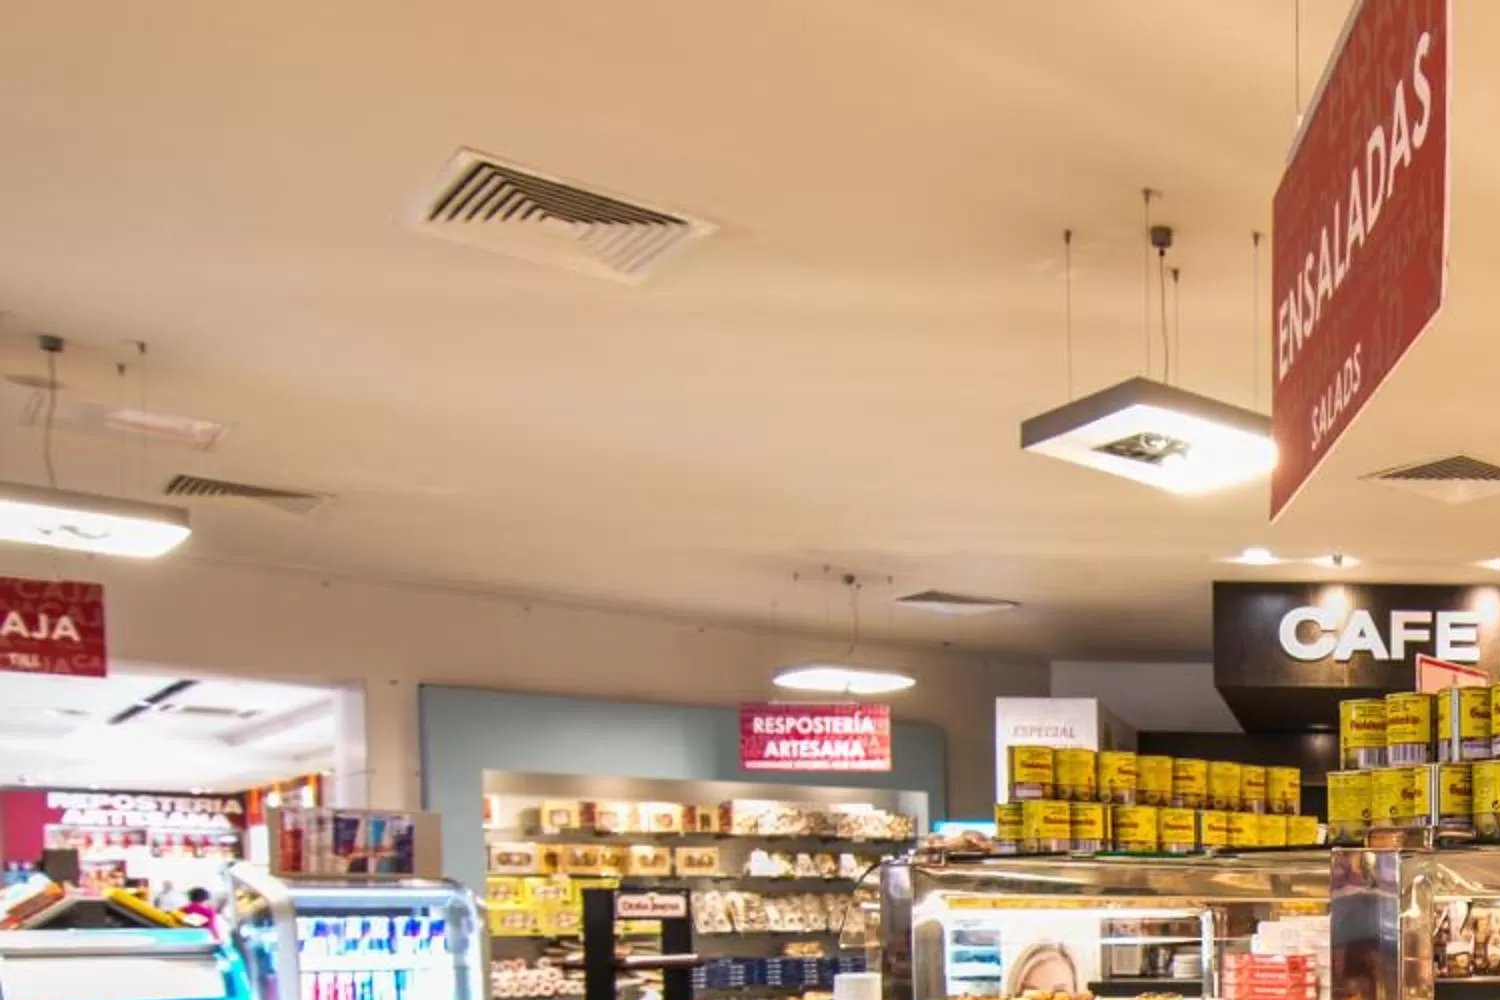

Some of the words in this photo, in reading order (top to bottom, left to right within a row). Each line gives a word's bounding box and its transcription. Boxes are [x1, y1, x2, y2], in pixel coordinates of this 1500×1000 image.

[1277, 31, 1432, 382] ENSALADAS
[1311, 342, 1362, 450] SALADS
[0, 610, 81, 642] AJA
[1279, 606, 1481, 662] CAFE
[753, 711, 875, 734] RESPOSTERÍA
[763, 739, 866, 758] ARTESANA
